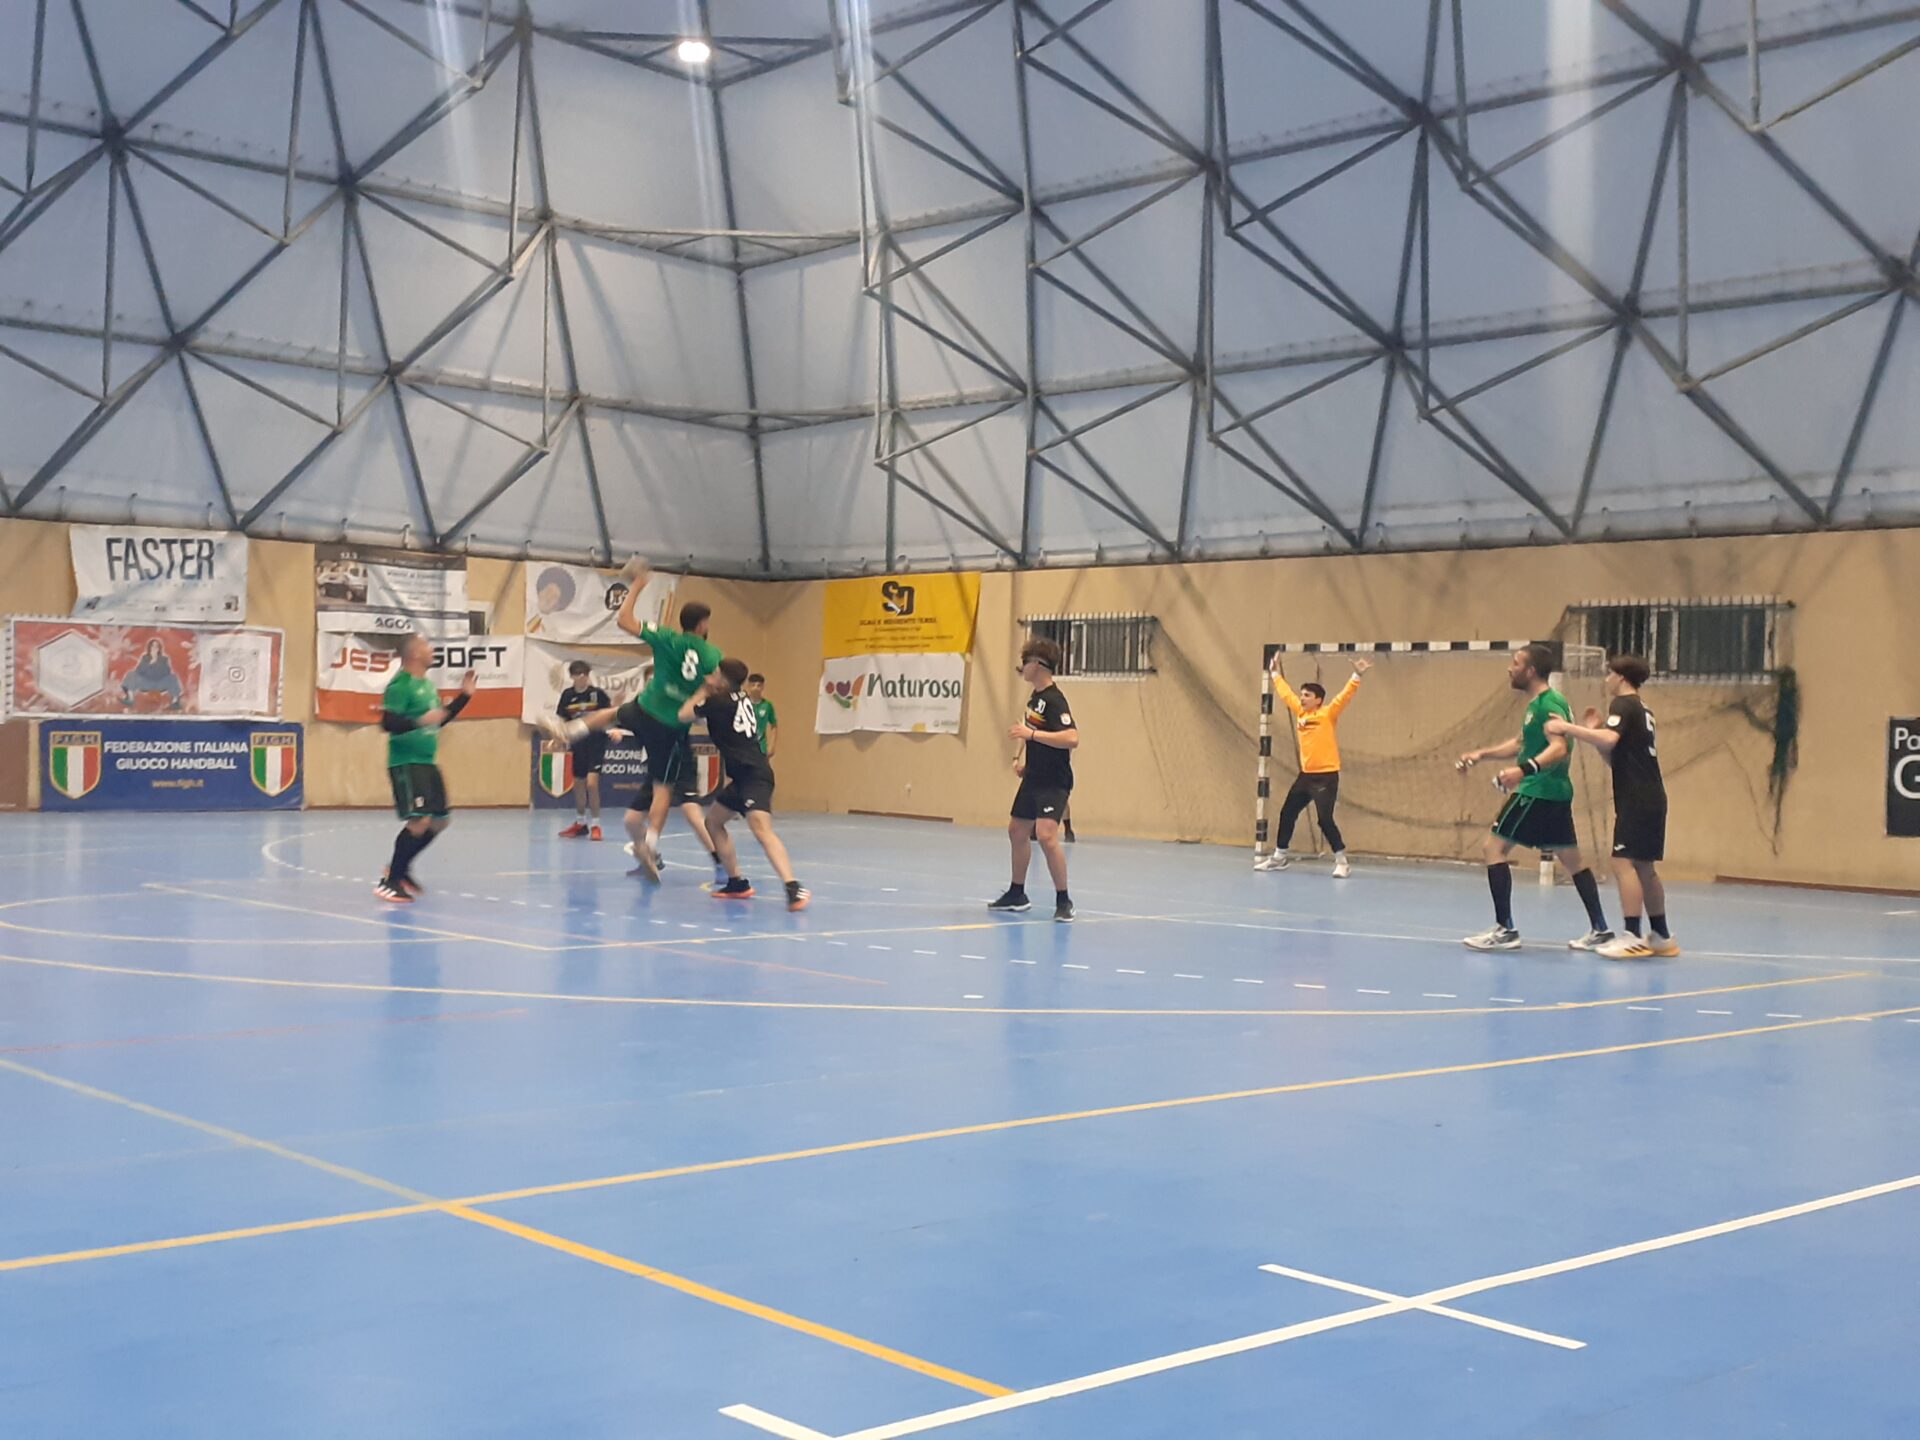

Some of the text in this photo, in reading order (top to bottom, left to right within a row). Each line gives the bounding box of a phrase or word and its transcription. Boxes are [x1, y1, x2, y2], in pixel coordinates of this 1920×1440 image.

[106, 537, 215, 580] FASTER
[681, 649, 699, 680] 8
[867, 673, 961, 699] Naturosa
[732, 697, 757, 738] 49
[103, 741, 249, 754] FEDERAZIONE ITALIANA
[116, 757, 237, 770] GIUOCO HANDBALL
